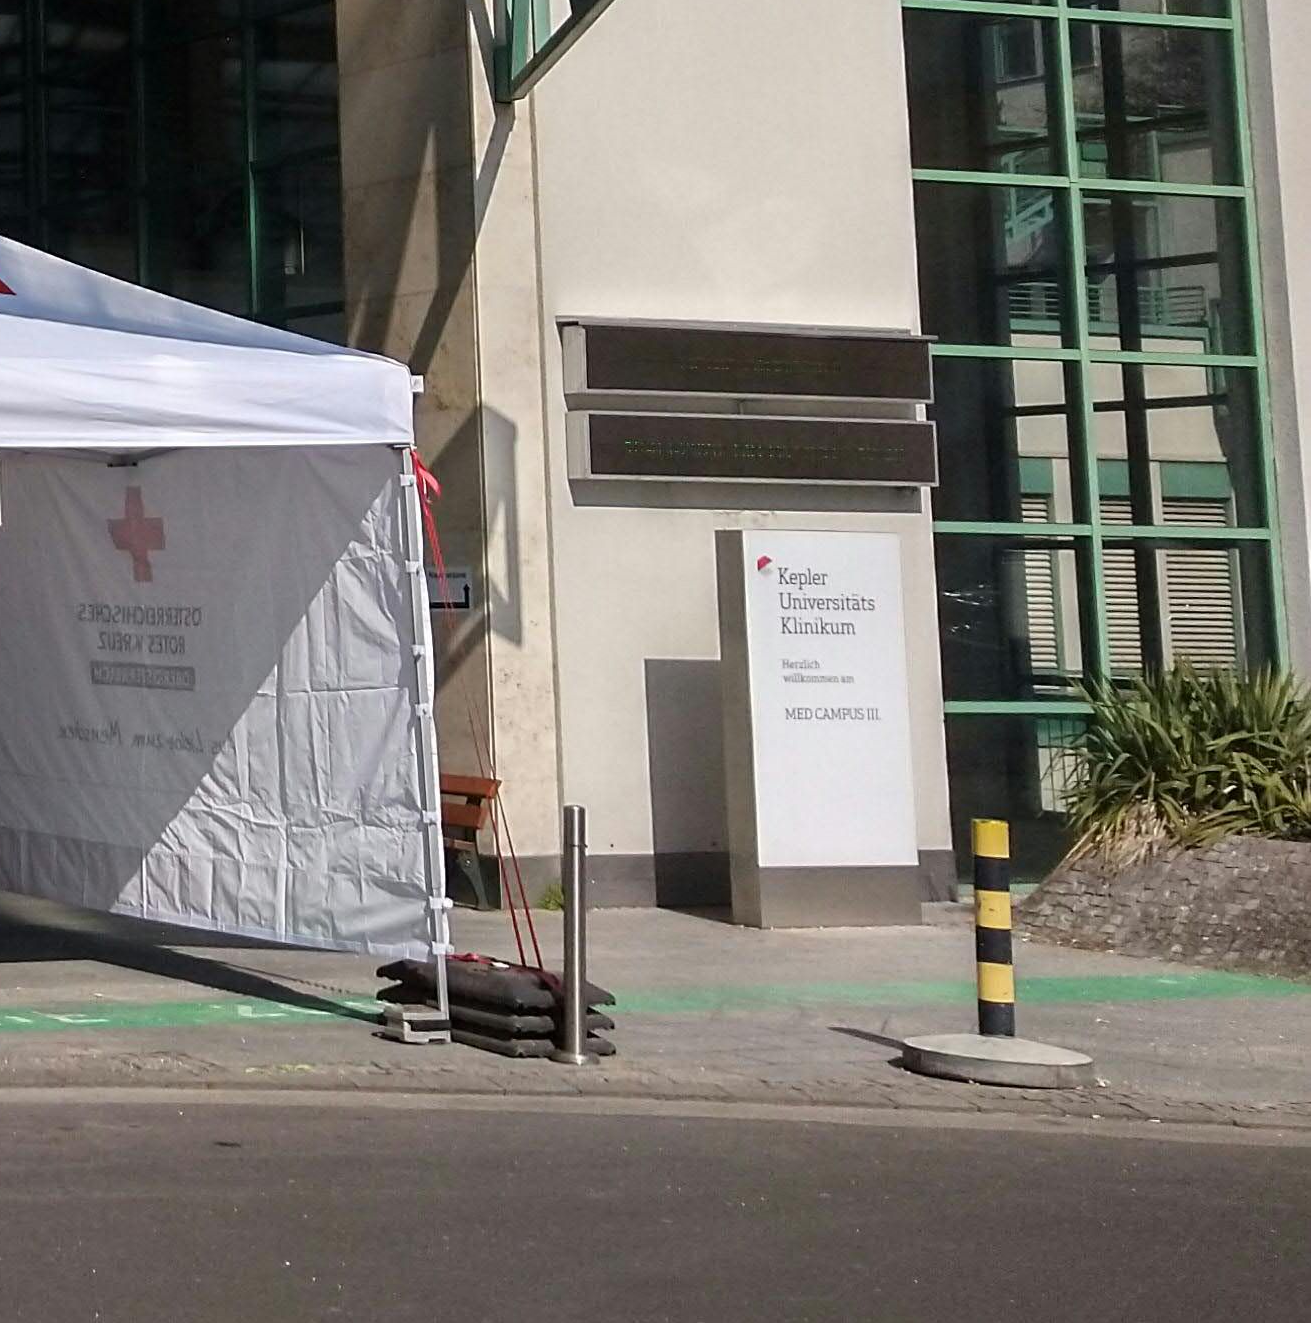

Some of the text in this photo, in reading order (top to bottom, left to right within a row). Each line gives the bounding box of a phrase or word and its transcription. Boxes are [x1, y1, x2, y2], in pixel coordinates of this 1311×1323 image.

[777, 567, 828, 590] Kepler
[778, 592, 876, 611] Universitäts
[780, 616, 856, 636] Klinikum
[781, 659, 821, 669] Herzlich
[785, 707, 813, 721] MED
[814, 707, 864, 721] CAMPUS
